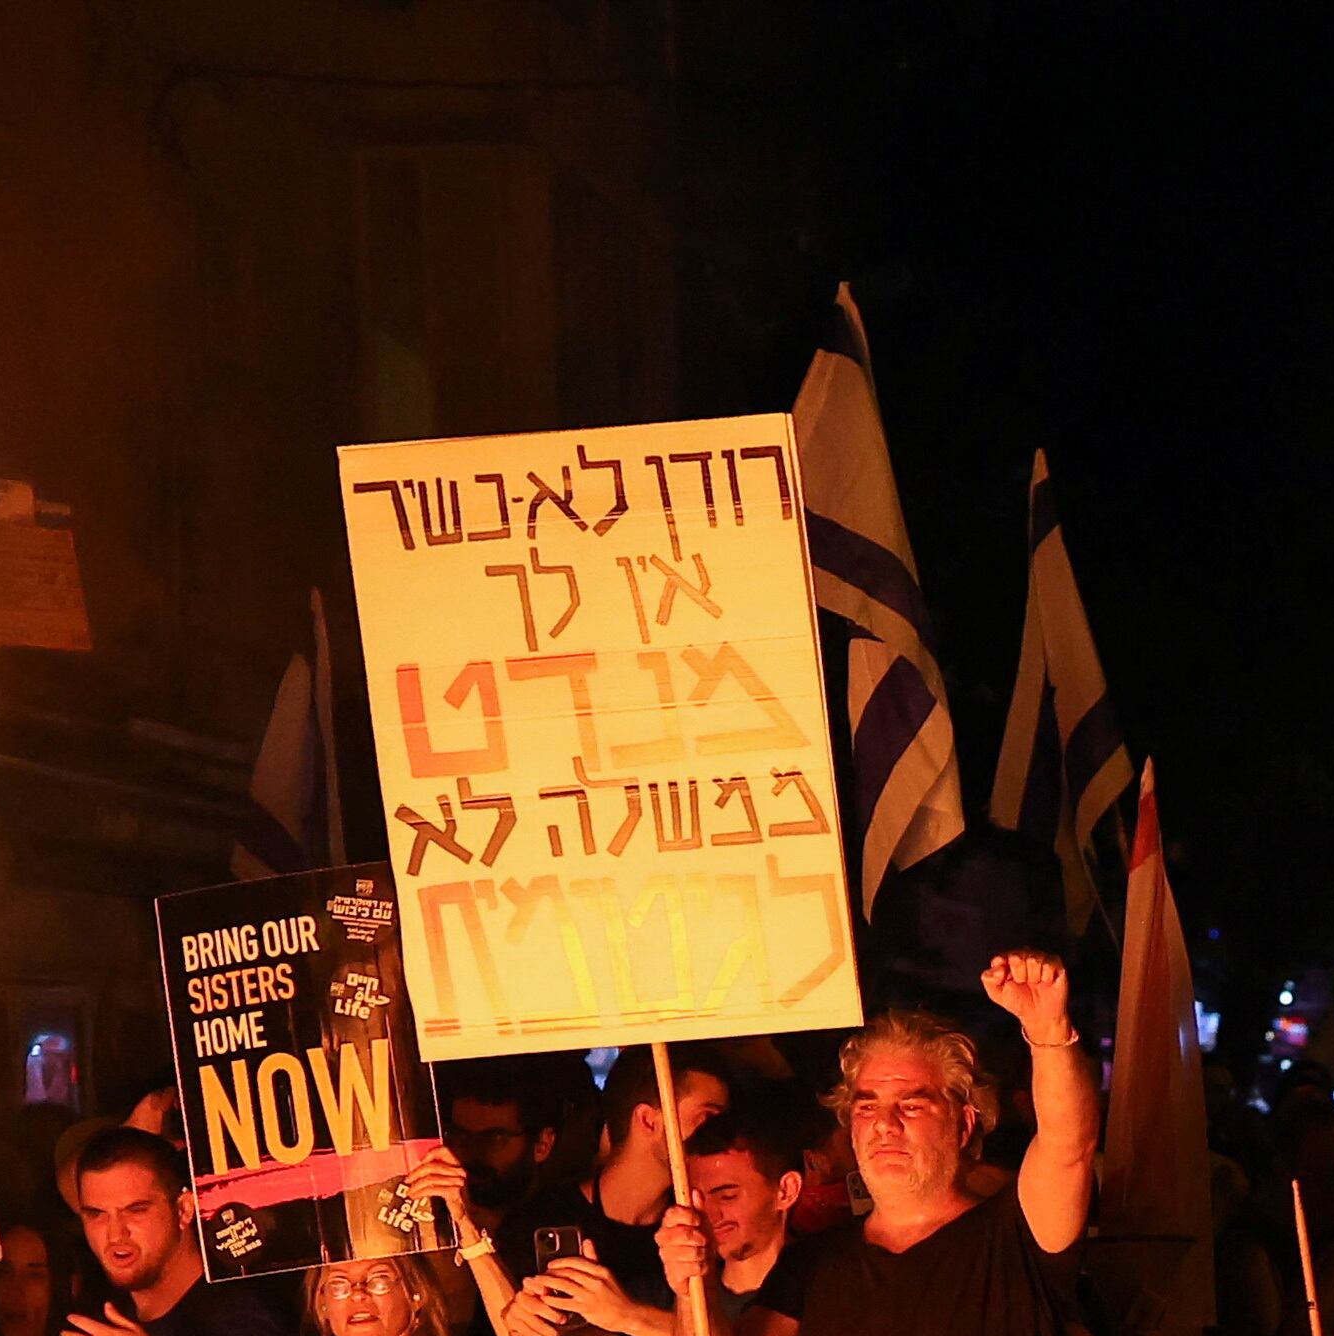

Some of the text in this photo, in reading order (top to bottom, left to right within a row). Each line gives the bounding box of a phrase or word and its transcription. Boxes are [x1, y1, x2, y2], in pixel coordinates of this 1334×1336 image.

[645, 446, 792, 561] רודן
[485, 547, 723, 650] אין לך
[397, 642, 811, 778] מנדט
[395, 777, 517, 876] לא
[182, 924, 259, 972] BRING
[262, 915, 319, 957] OUR
[188, 963, 295, 1014] SISTERS
[335, 999, 370, 1019] Life
[193, 1011, 267, 1057] HOME
[199, 1039, 389, 1175] NOW
[378, 1207, 413, 1232] Life
